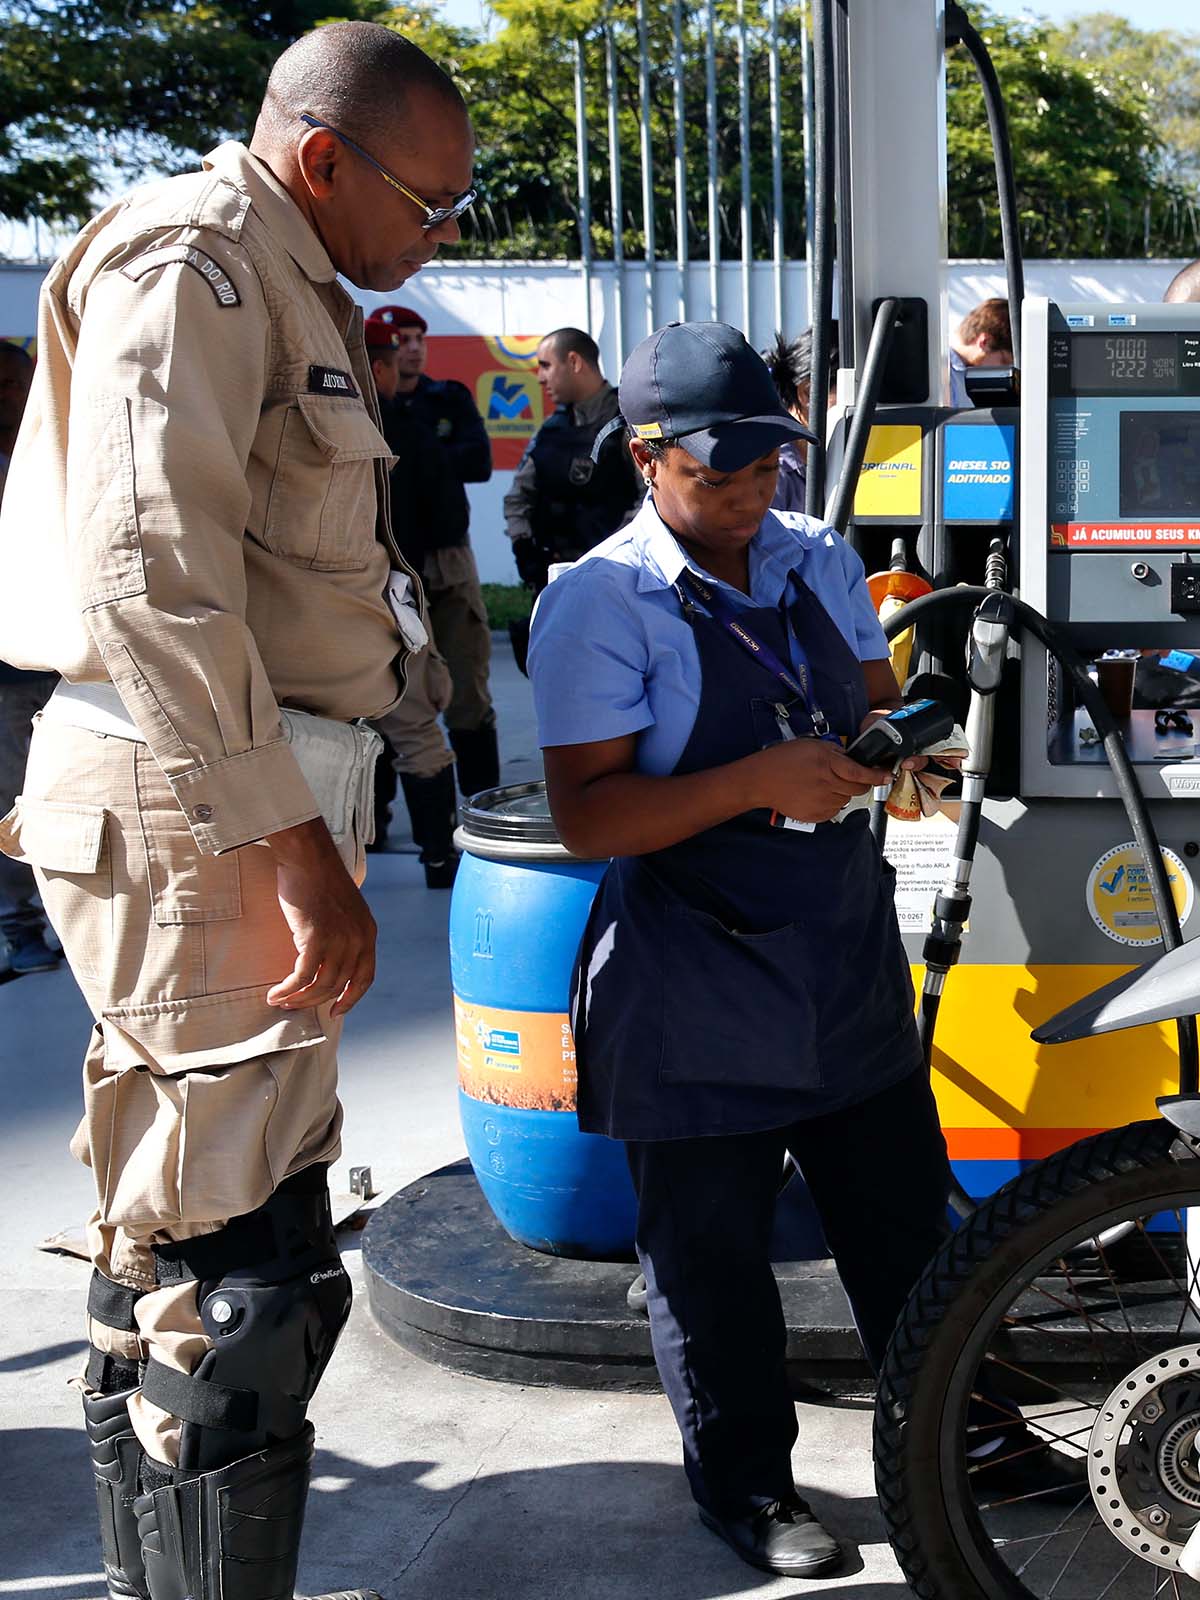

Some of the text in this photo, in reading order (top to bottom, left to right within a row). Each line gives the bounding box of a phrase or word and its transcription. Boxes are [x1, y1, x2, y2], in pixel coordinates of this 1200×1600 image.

[201, 260, 237, 304] DO RIO
[948, 460, 988, 471] DIESEL
[947, 474, 1011, 484] ADITIVADO
[1072, 525, 1088, 541] JÁ
[1091, 528, 1152, 541] ACUMULOU
[1155, 528, 1185, 540] SEUS
